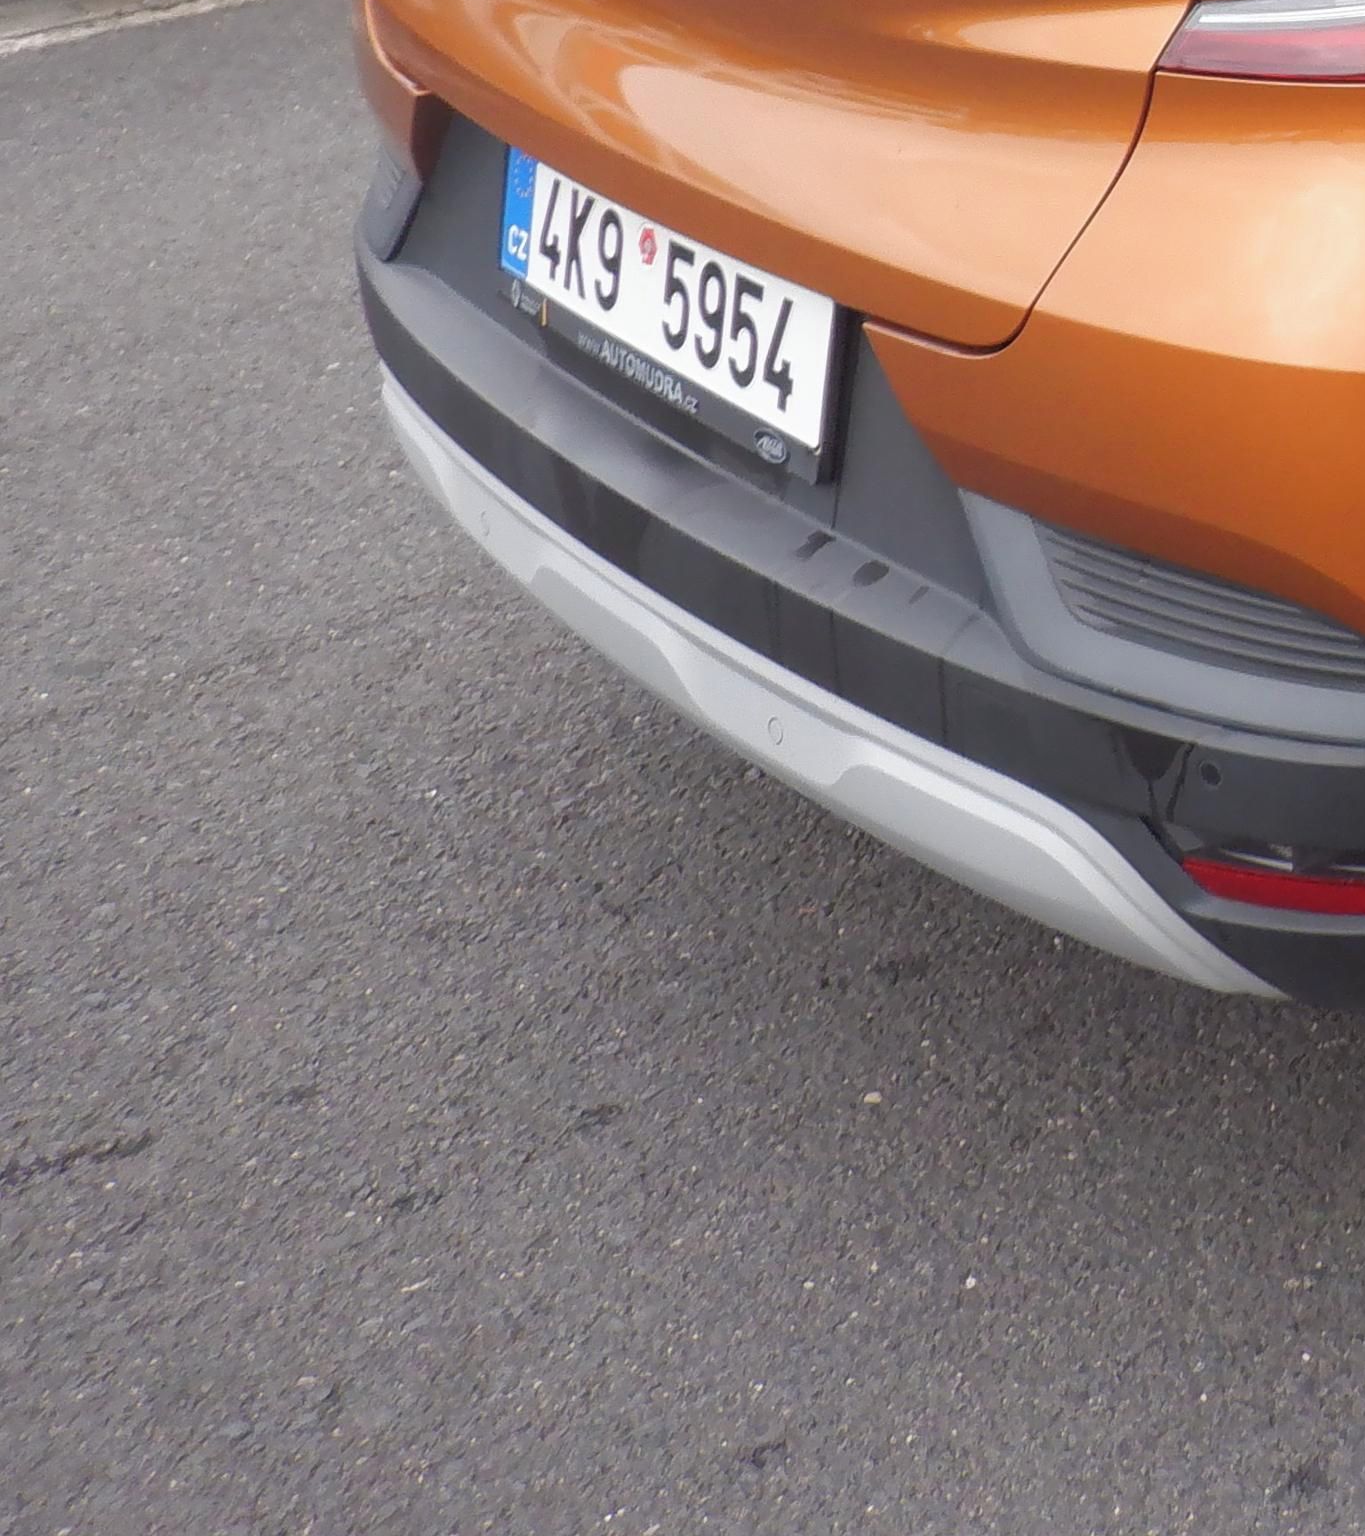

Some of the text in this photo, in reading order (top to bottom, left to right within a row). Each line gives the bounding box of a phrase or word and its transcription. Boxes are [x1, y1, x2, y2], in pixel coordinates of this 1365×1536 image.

[507, 223, 529, 262] CZ
[539, 177, 794, 414] 4K9 5954
